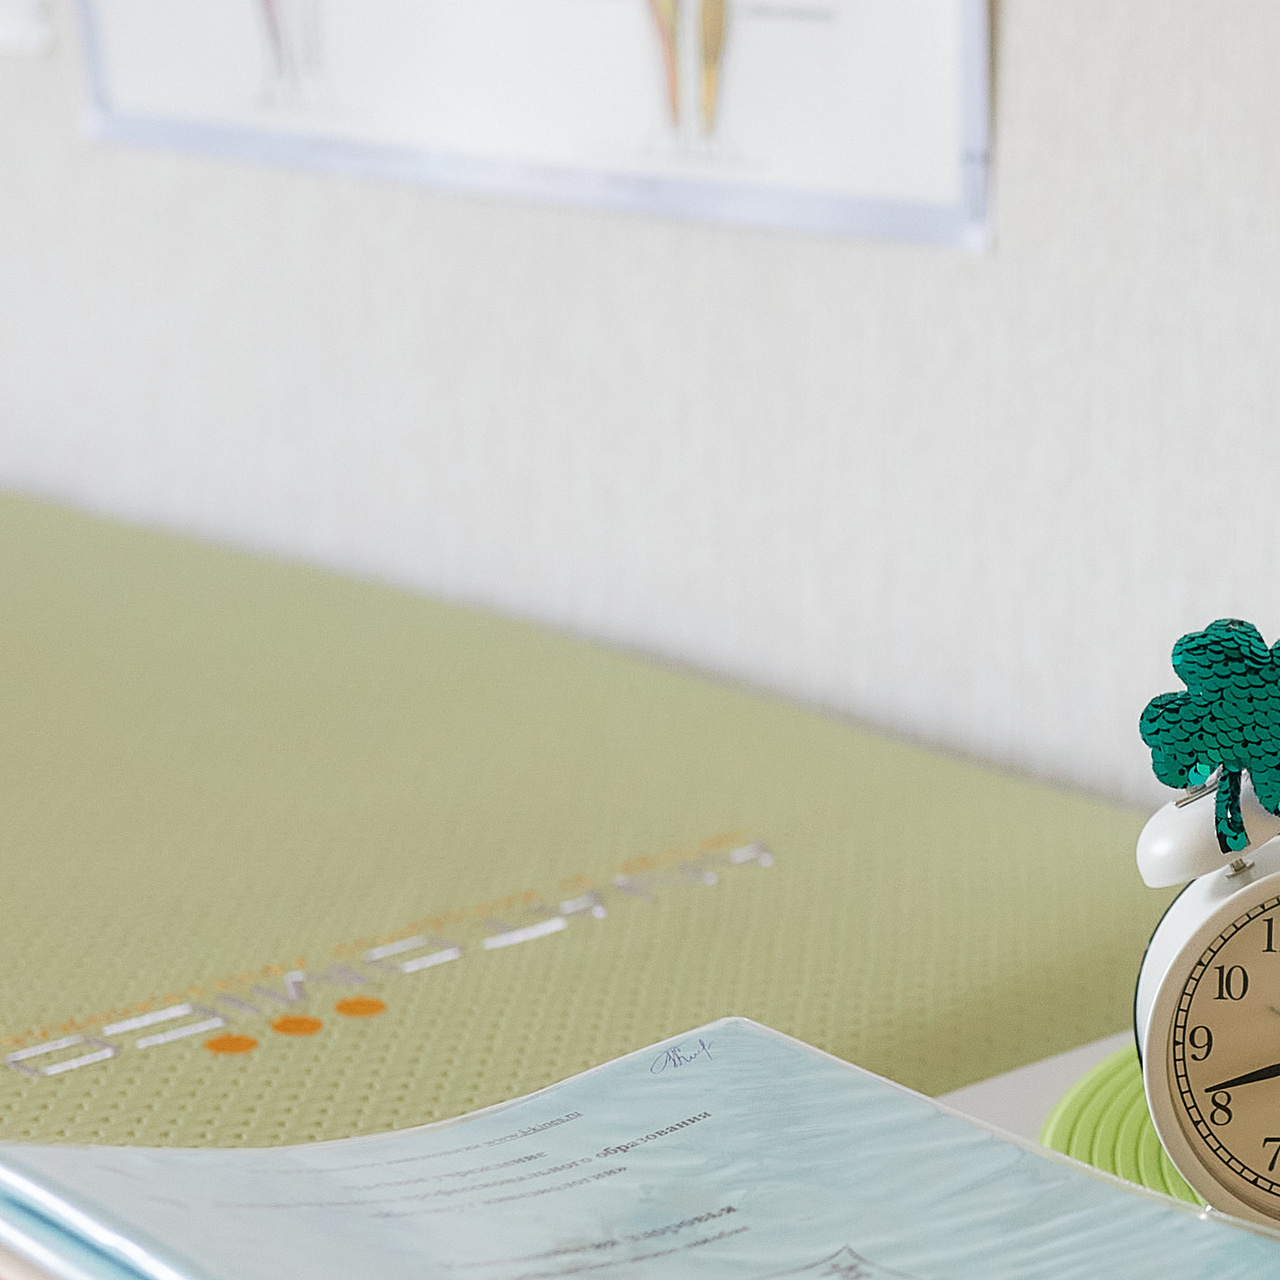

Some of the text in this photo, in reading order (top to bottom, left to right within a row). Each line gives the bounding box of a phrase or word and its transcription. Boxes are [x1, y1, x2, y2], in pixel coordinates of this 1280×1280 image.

[1213, 964, 1249, 1001] 10
[1189, 1025, 1213, 1061] 9
[1209, 1091, 1233, 1126] 8
[595, 1111, 712, 1158] образования
